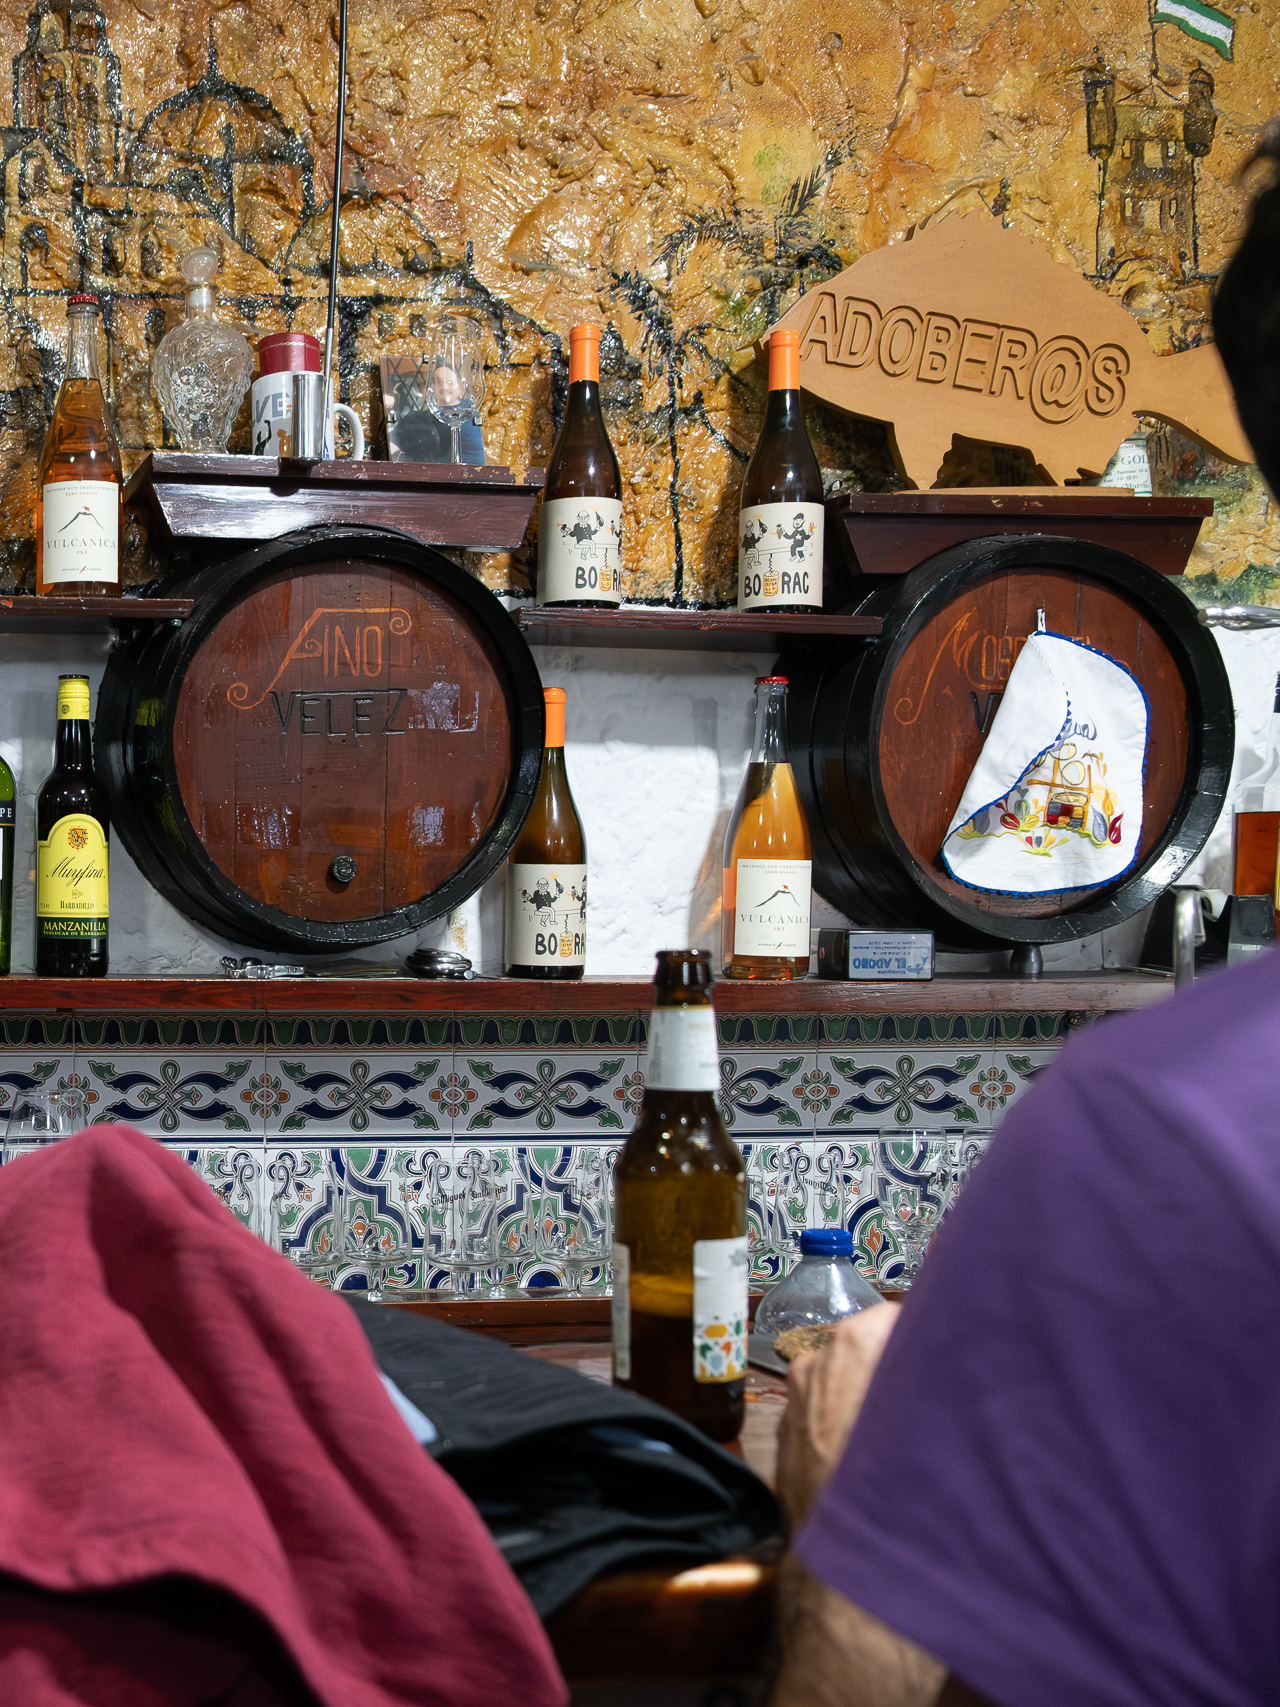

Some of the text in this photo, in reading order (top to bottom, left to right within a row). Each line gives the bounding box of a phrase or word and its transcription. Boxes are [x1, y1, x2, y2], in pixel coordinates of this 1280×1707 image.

[799, 291, 1131, 425] ADOBER@S
[47, 538, 116, 549] VULCANICA
[268, 688, 408, 735] VELEZ
[44, 921, 106, 930] MANZANILLA
